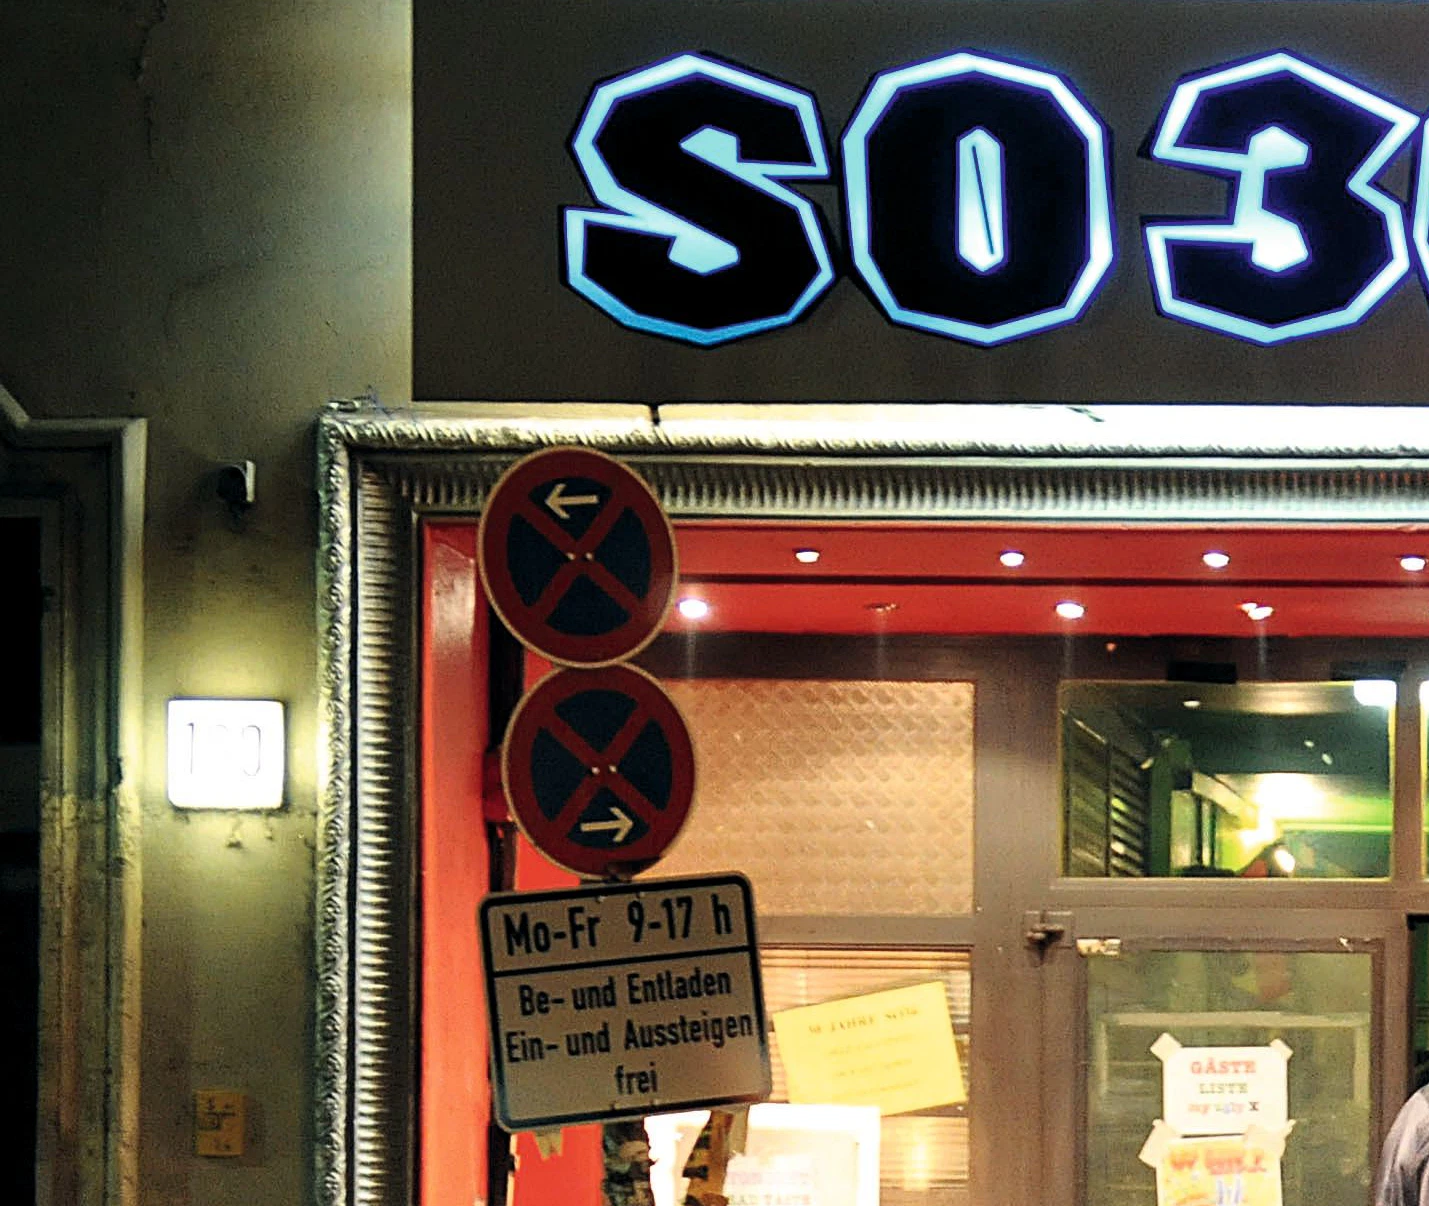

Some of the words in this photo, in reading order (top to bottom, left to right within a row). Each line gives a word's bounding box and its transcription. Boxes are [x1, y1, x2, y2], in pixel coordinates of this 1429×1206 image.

[503, 906, 600, 956] Mo-Fr
[627, 896, 693, 943] 9-17
[712, 893, 732, 935] h
[518, 985, 564, 1016] Be-
[571, 975, 617, 1010] und
[627, 967, 731, 1005] Entladen
[506, 1031, 558, 1062] Ein-
[566, 1022, 611, 1056] und
[624, 1011, 752, 1050] Aussteigen
[614, 1062, 658, 1095] frei
